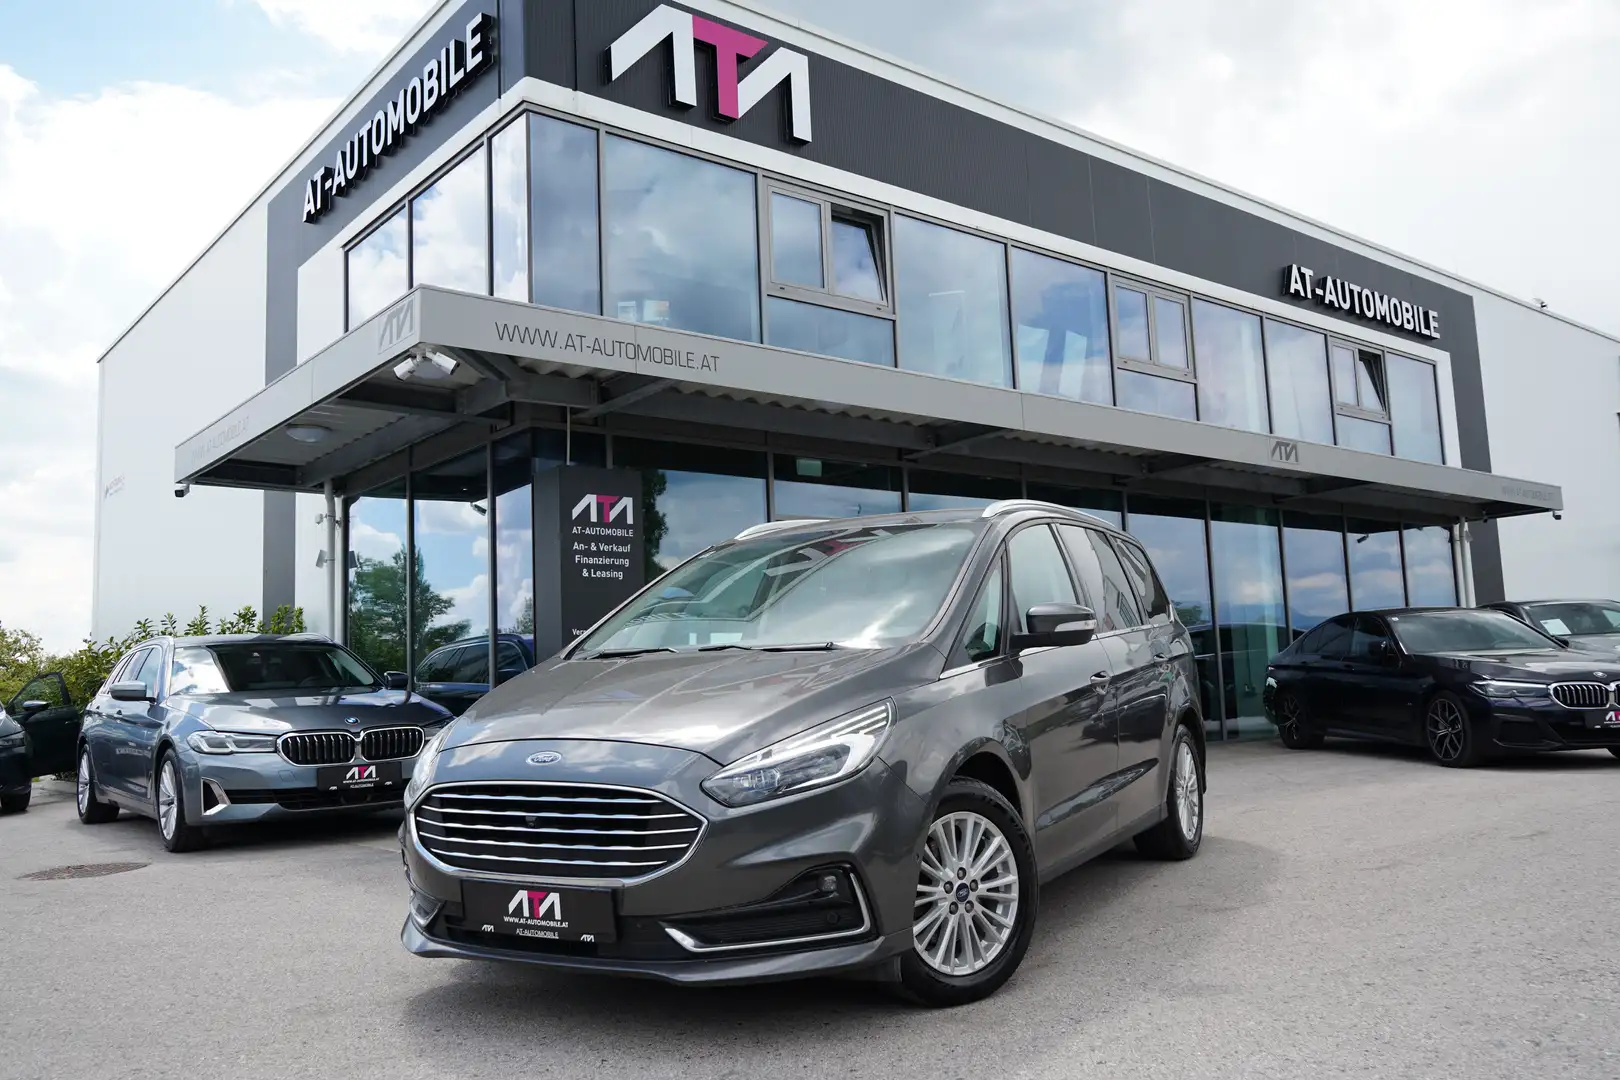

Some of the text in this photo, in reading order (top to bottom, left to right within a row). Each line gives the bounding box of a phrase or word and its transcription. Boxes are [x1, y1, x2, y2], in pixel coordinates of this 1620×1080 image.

[610, 3, 812, 142] ATA
[302, 12, 483, 222] AT-AUTOMOBILE
[1289, 263, 1441, 339] AT-AUTOMOBILE
[495, 321, 720, 373] WWW.AT-AUTOMOBILE.AT
[571, 526, 634, 537] AT-AUTOMOBILE
[572, 541, 631, 553] An- & Verkauf
[575, 555, 630, 567] Finanzierung
[582, 568, 624, 580] & Leasing
[503, 916, 569, 928] WWW.AT-AUTOMOBILE.AT
[516, 928, 559, 939] AT-AUTOMOBILE
